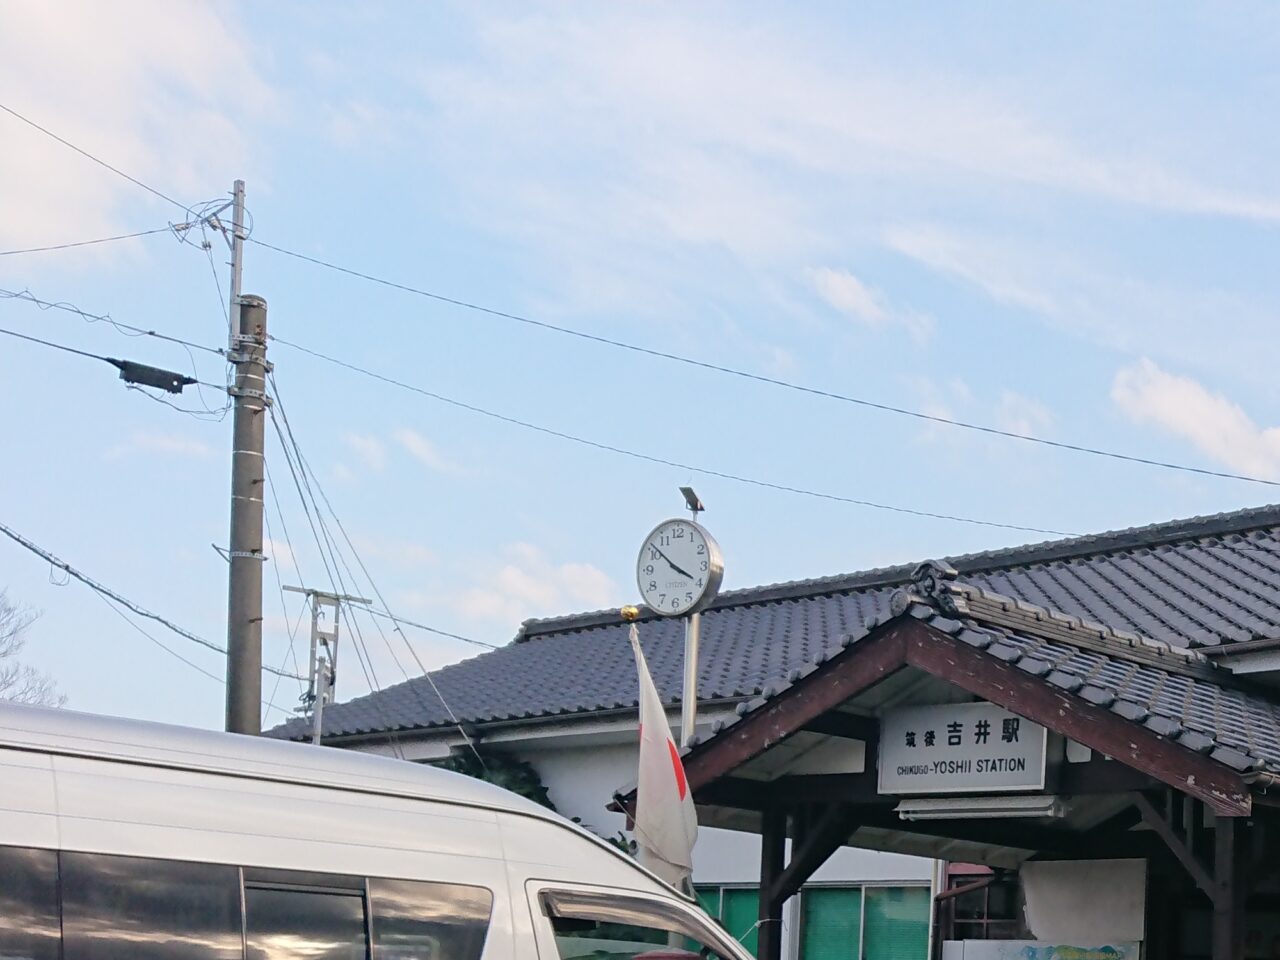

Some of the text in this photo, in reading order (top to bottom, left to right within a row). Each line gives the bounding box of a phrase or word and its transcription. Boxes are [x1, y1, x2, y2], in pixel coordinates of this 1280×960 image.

[672, 528, 684, 539] 12
[690, 532, 694, 542] 1
[660, 536, 670, 546] 11
[697, 544, 704, 555] 2
[651, 550, 661, 560] 10
[646, 565, 654, 575] 9
[700, 561, 707, 571] 3
[648, 581, 657, 591] 8
[695, 578, 703, 588] 4
[659, 594, 666, 605] 7
[685, 592, 692, 602] 5
[671, 598, 679, 608] 6
[897, 757, 1026, 776] CHIKUGO-YOSHII STATION
